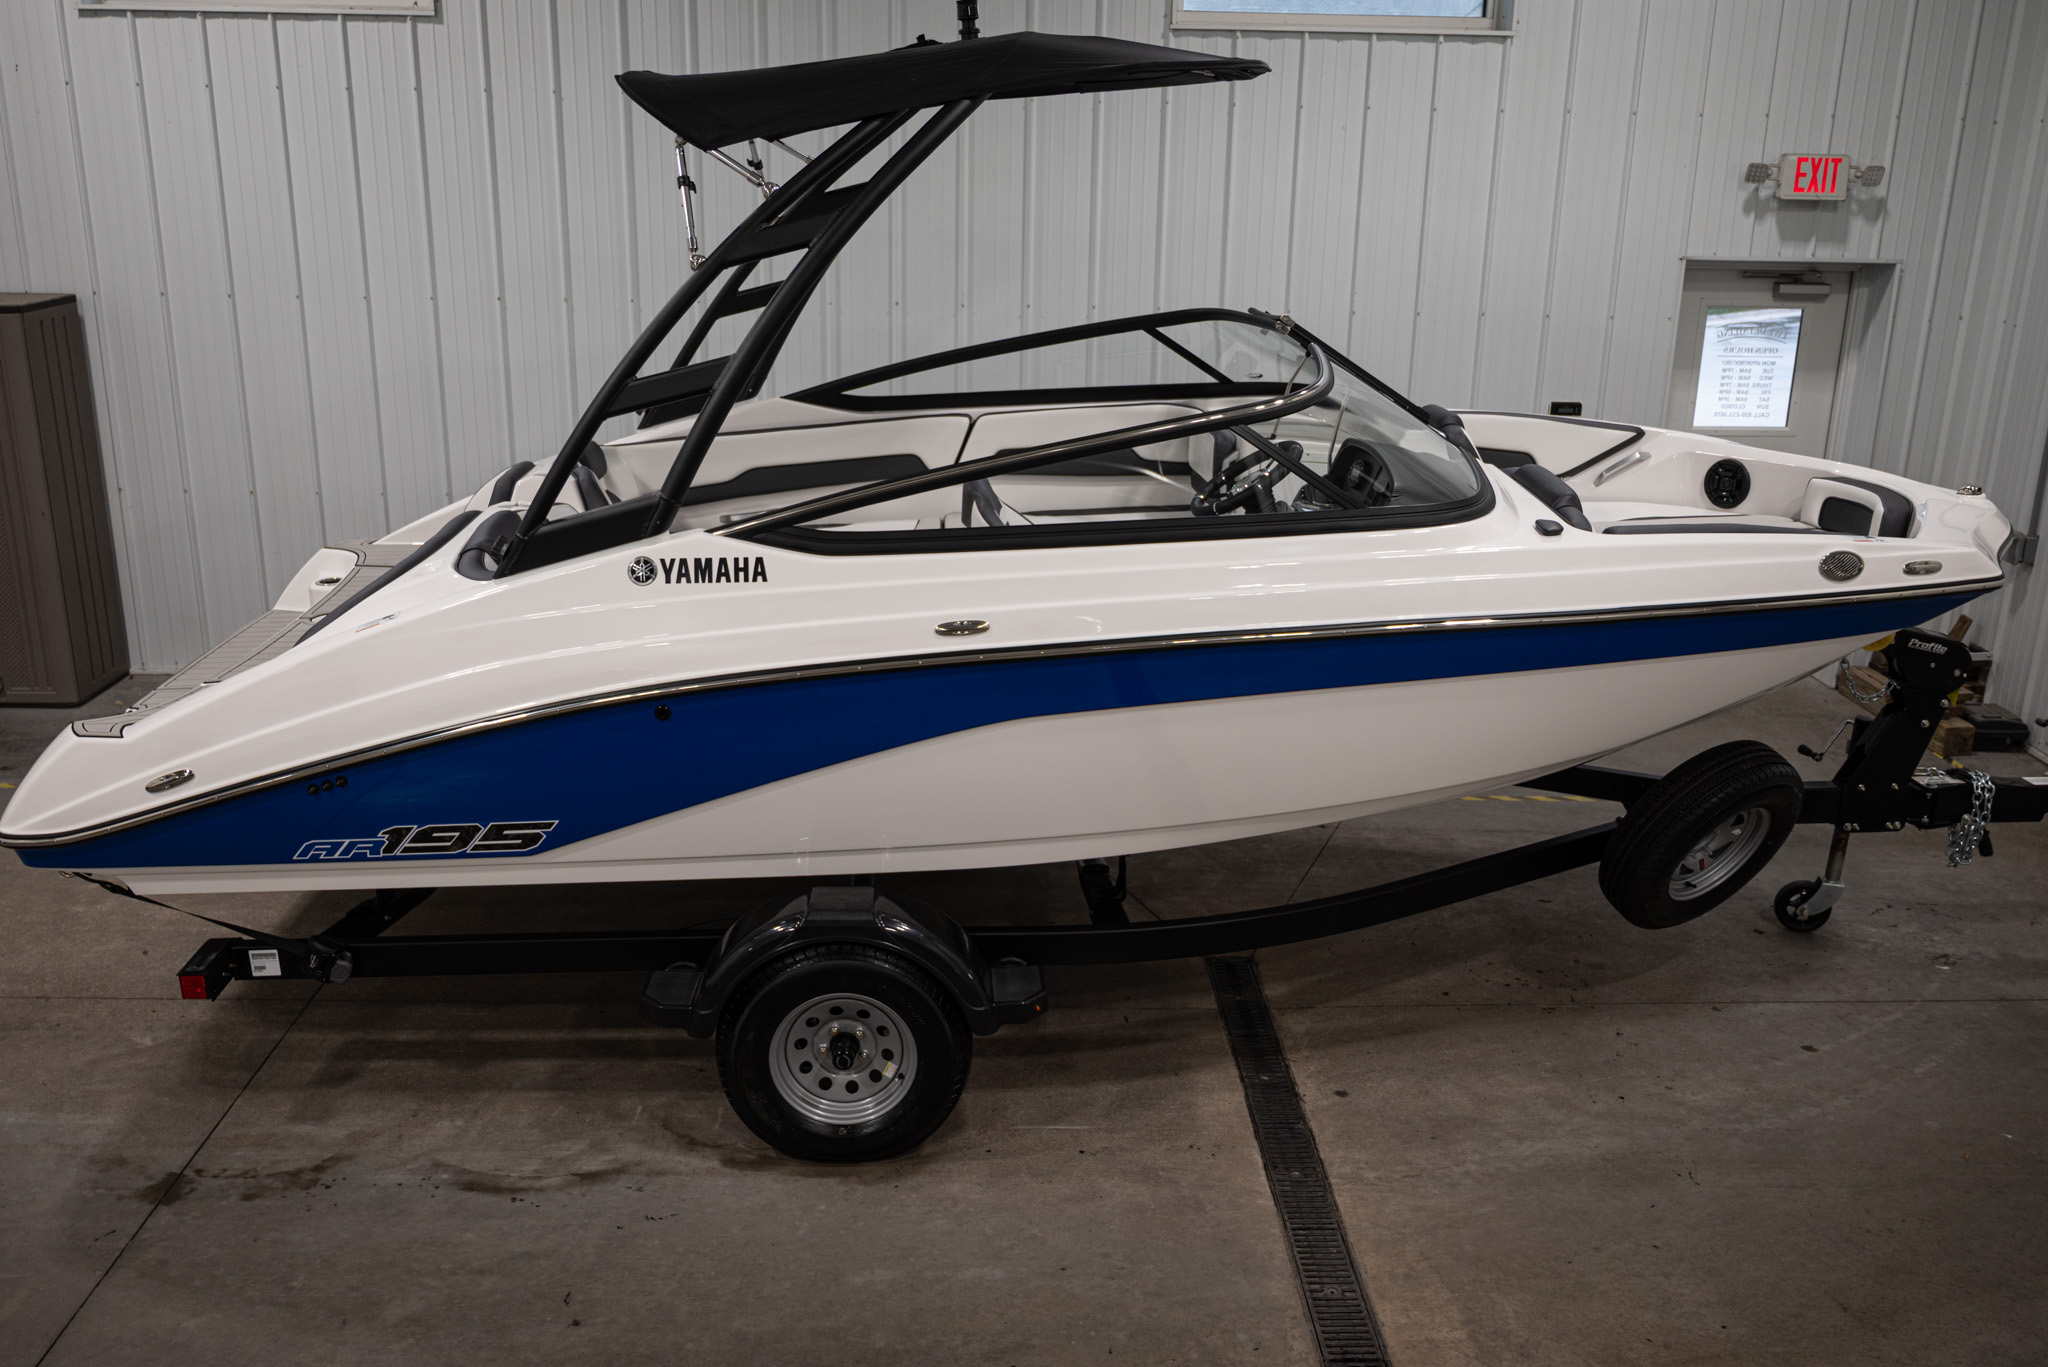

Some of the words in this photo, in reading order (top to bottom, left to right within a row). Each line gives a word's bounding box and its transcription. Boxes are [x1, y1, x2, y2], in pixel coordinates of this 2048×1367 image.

[1793, 156, 1843, 194] EXIT
[659, 556, 768, 584] YAMAHA
[1908, 638, 1948, 653] Profile
[292, 819, 560, 860] AR195
